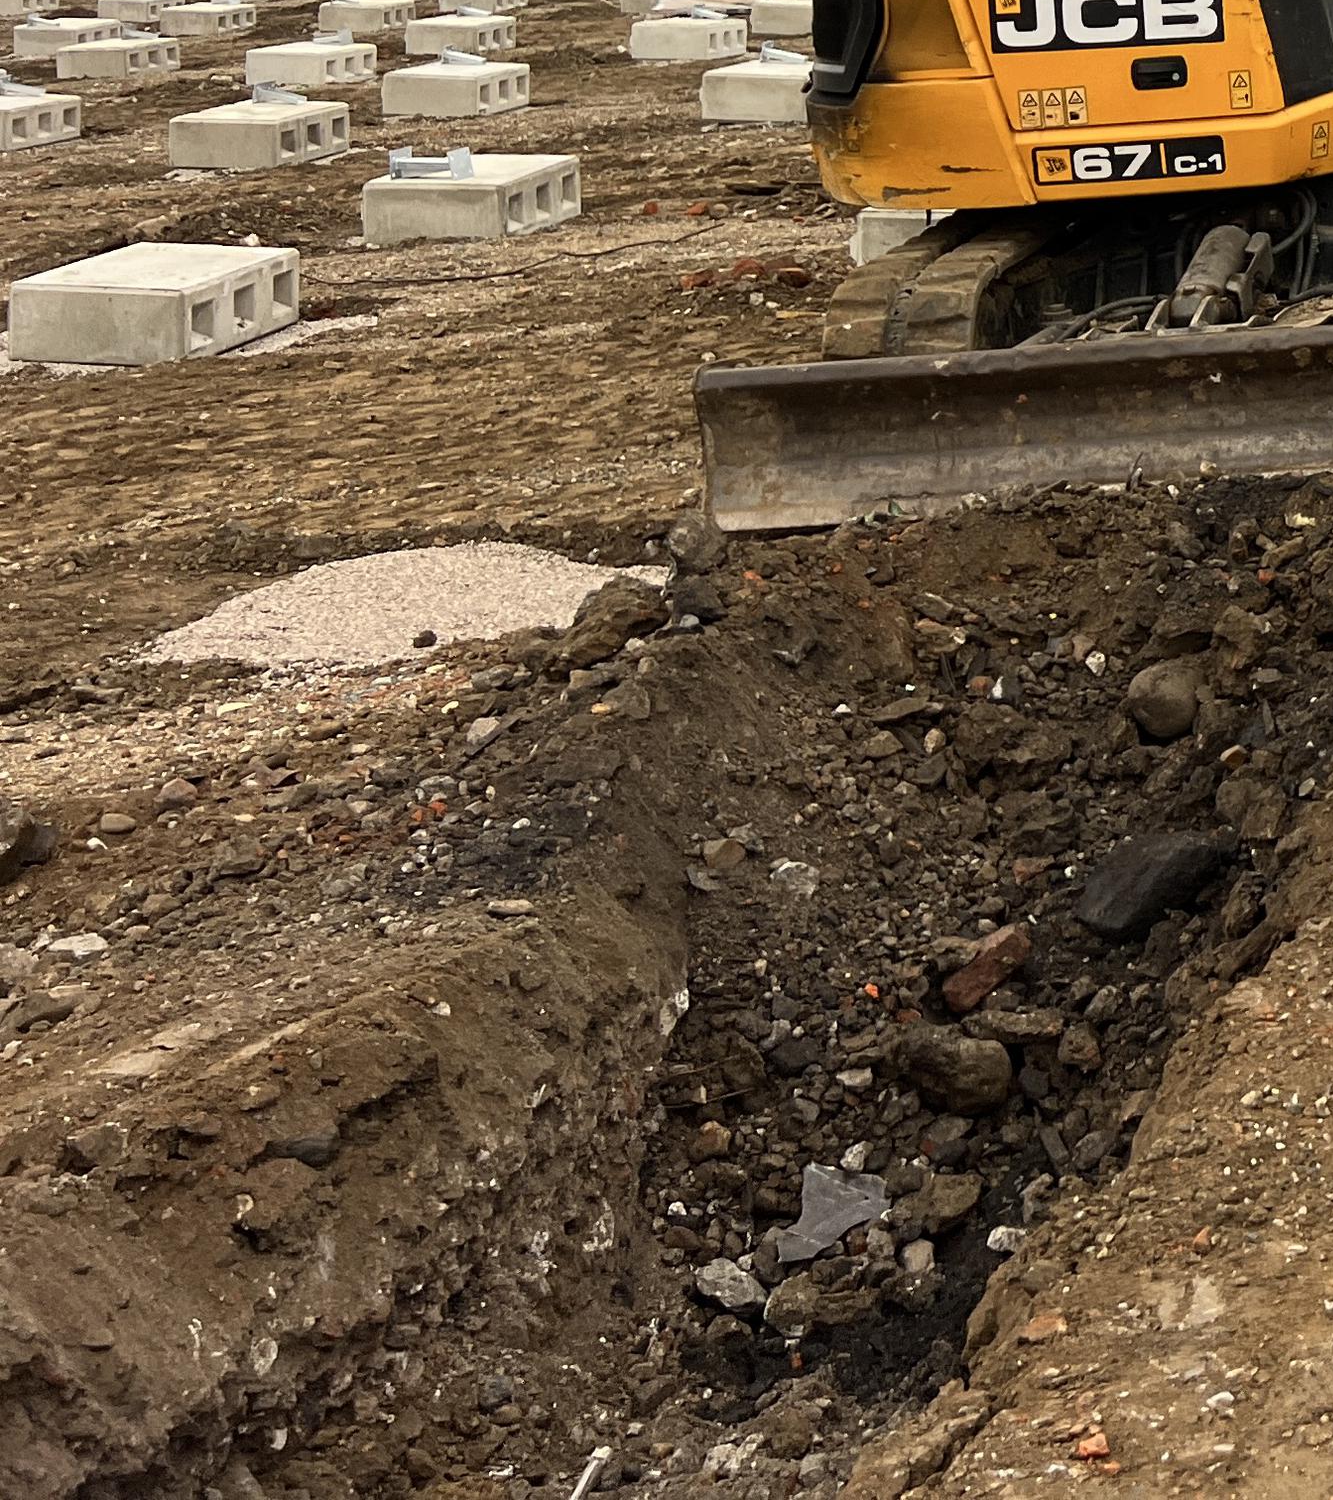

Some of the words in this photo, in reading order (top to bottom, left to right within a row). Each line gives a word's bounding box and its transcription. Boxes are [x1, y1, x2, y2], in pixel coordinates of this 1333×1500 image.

[1045, 156, 1068, 176] JCB
[1072, 144, 1152, 180] 67
[1173, 153, 1224, 174] C-1
